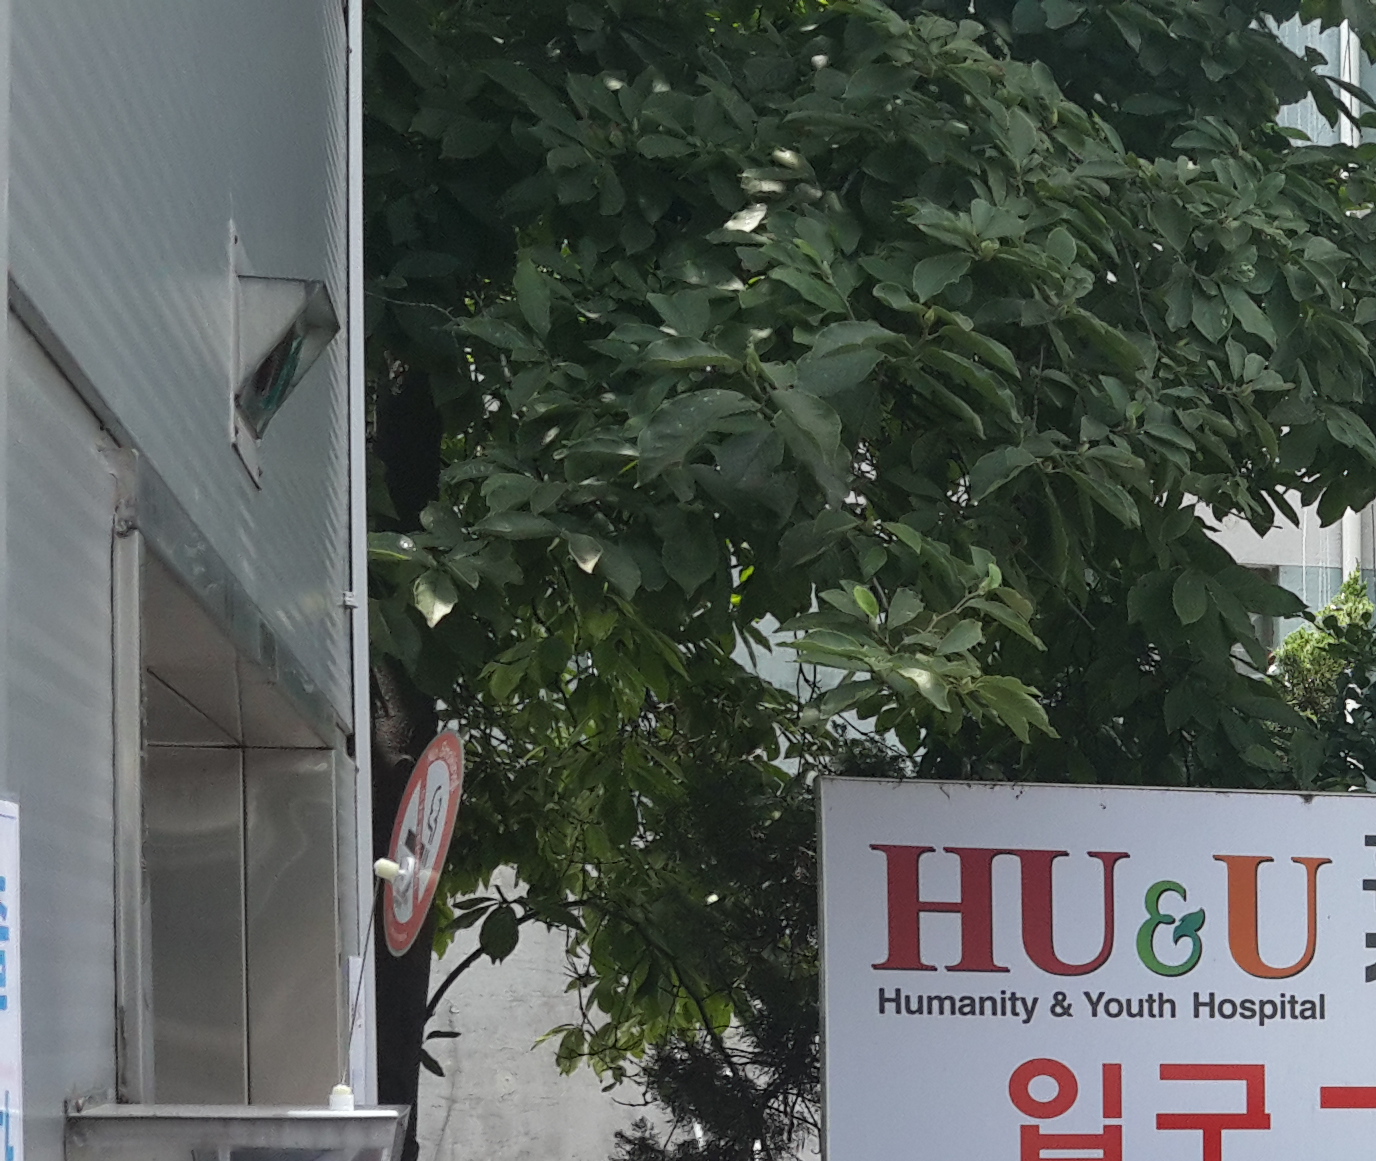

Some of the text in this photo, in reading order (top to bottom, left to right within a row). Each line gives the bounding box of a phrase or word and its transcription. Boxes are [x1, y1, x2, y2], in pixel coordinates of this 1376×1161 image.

[870, 843, 1332, 979] HU&U
[878, 987, 1326, 1027] Humanity & Youth Hospital
